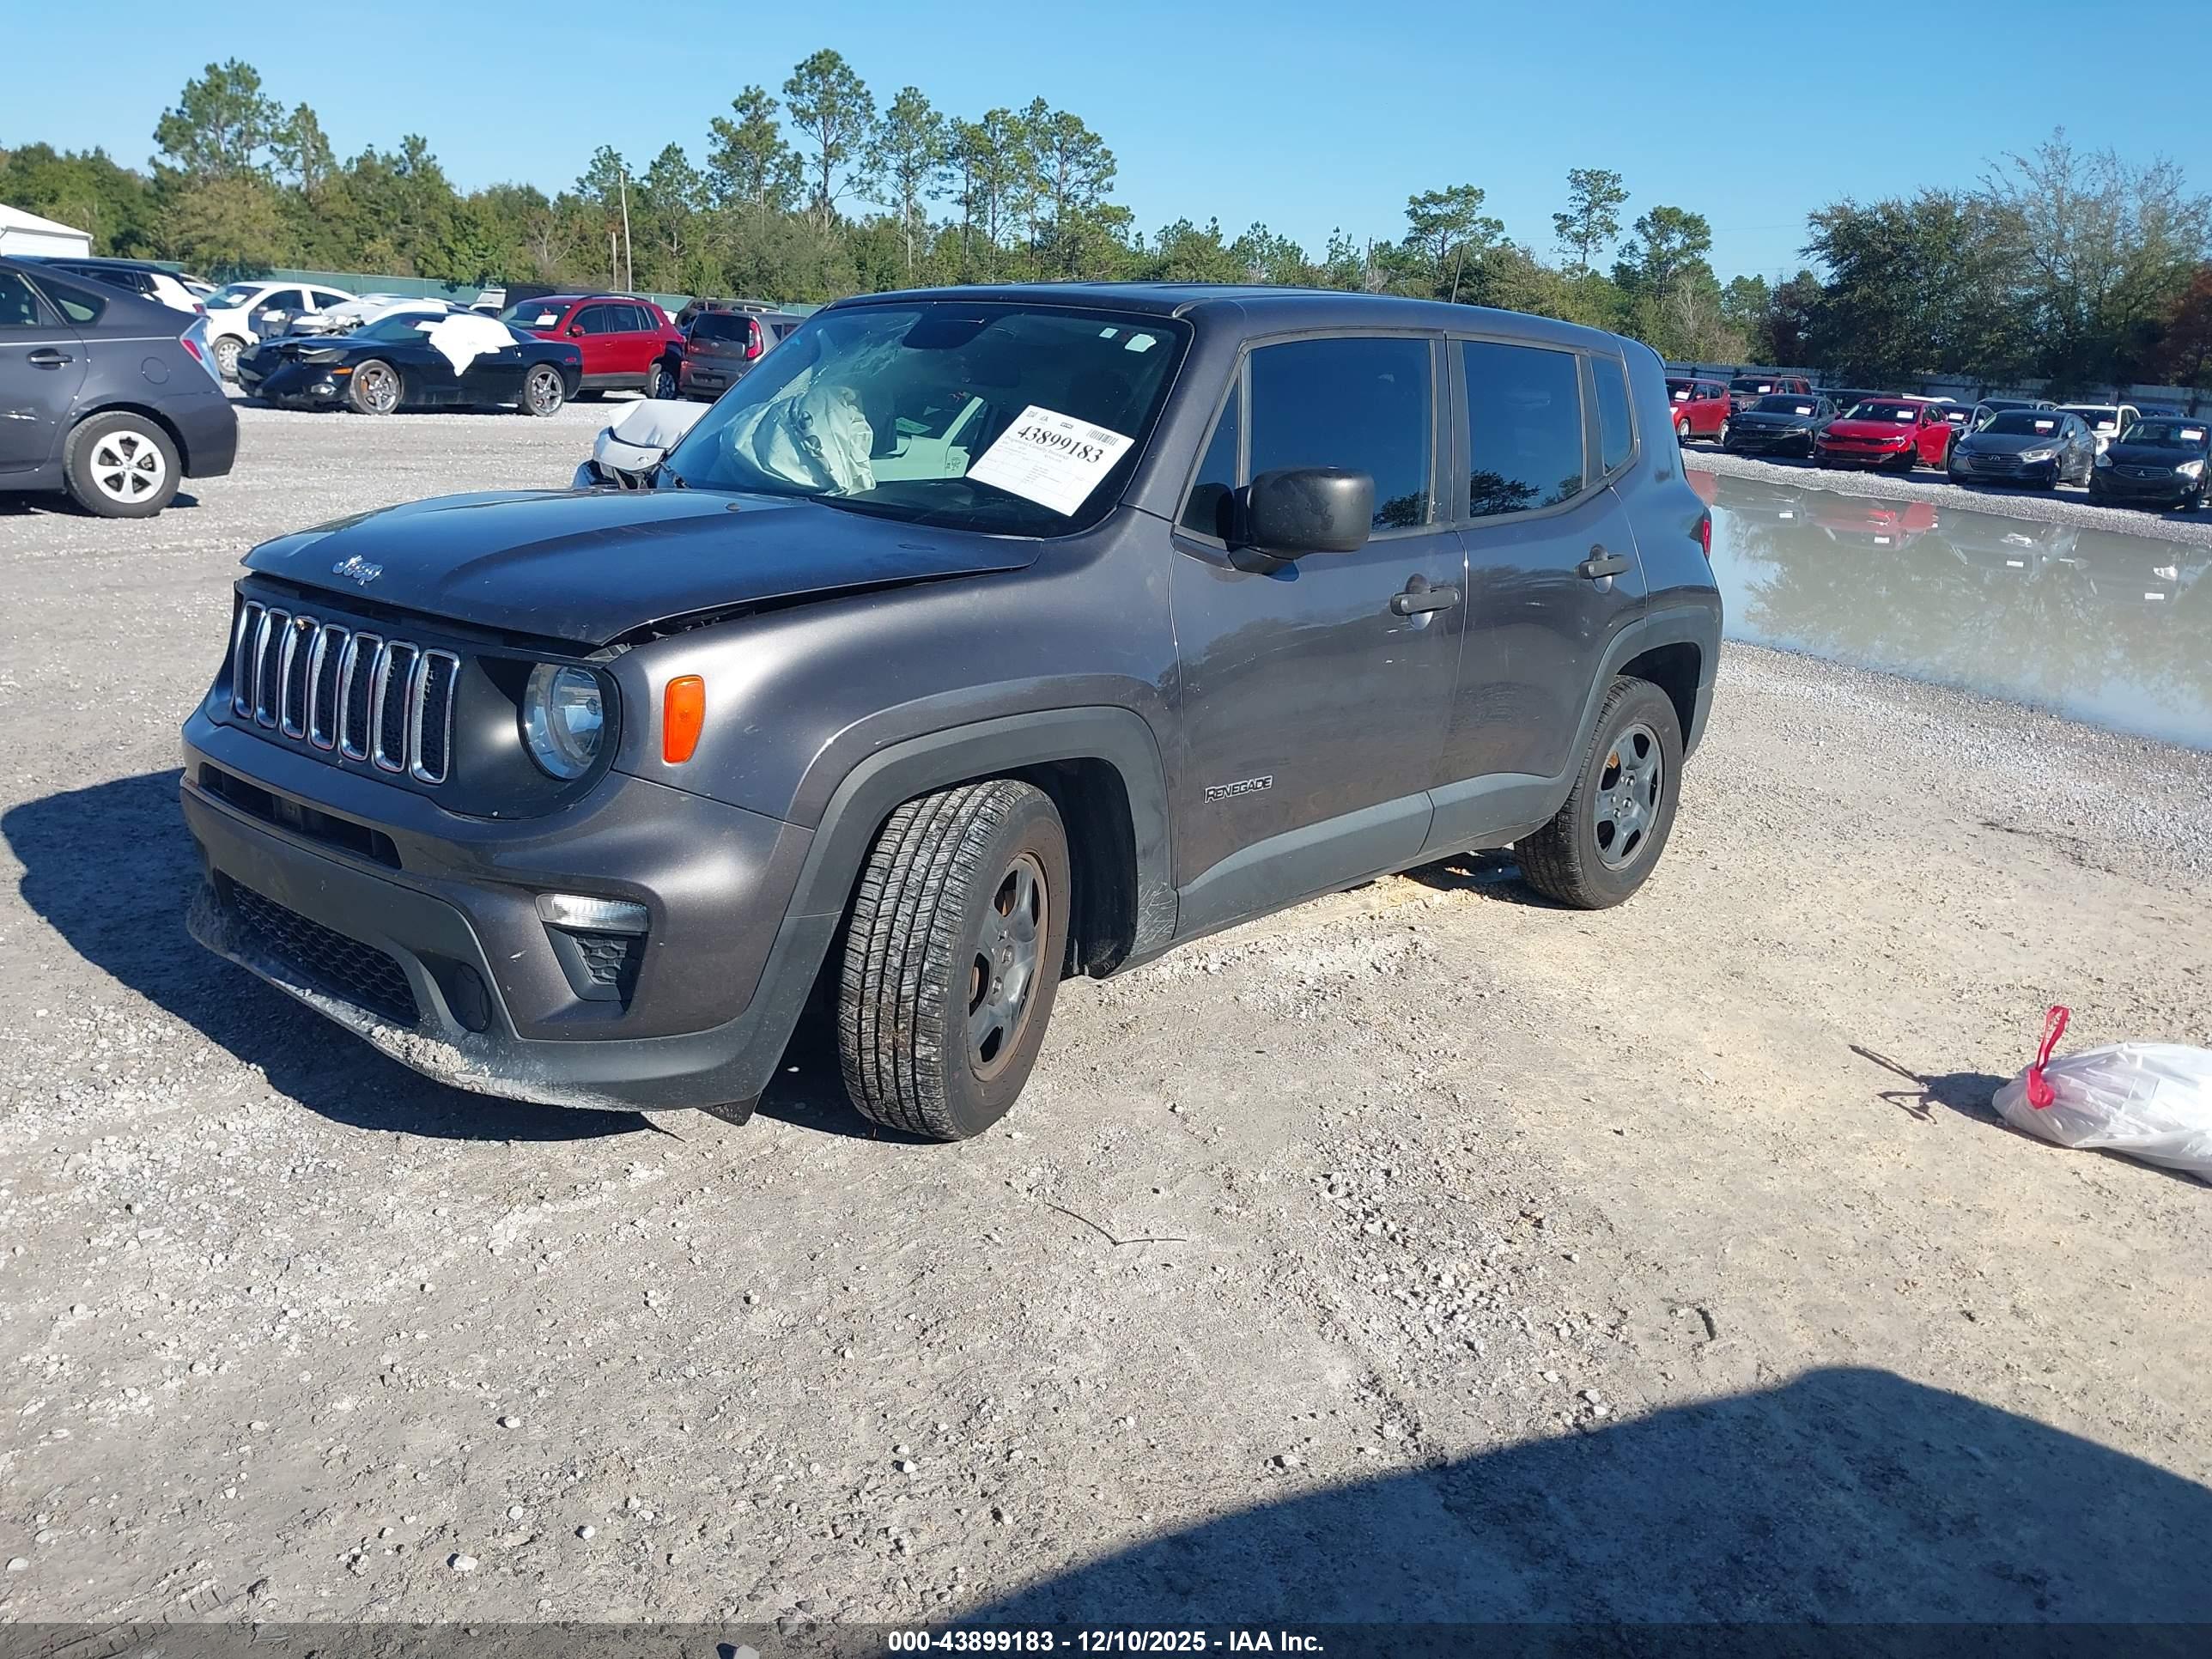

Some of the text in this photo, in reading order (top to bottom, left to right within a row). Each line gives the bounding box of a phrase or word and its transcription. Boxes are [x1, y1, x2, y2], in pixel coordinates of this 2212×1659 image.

[1017, 425, 1104, 464] 43899183
[332, 555, 384, 586] Jeep
[1204, 775, 1274, 804] RENEGADE
